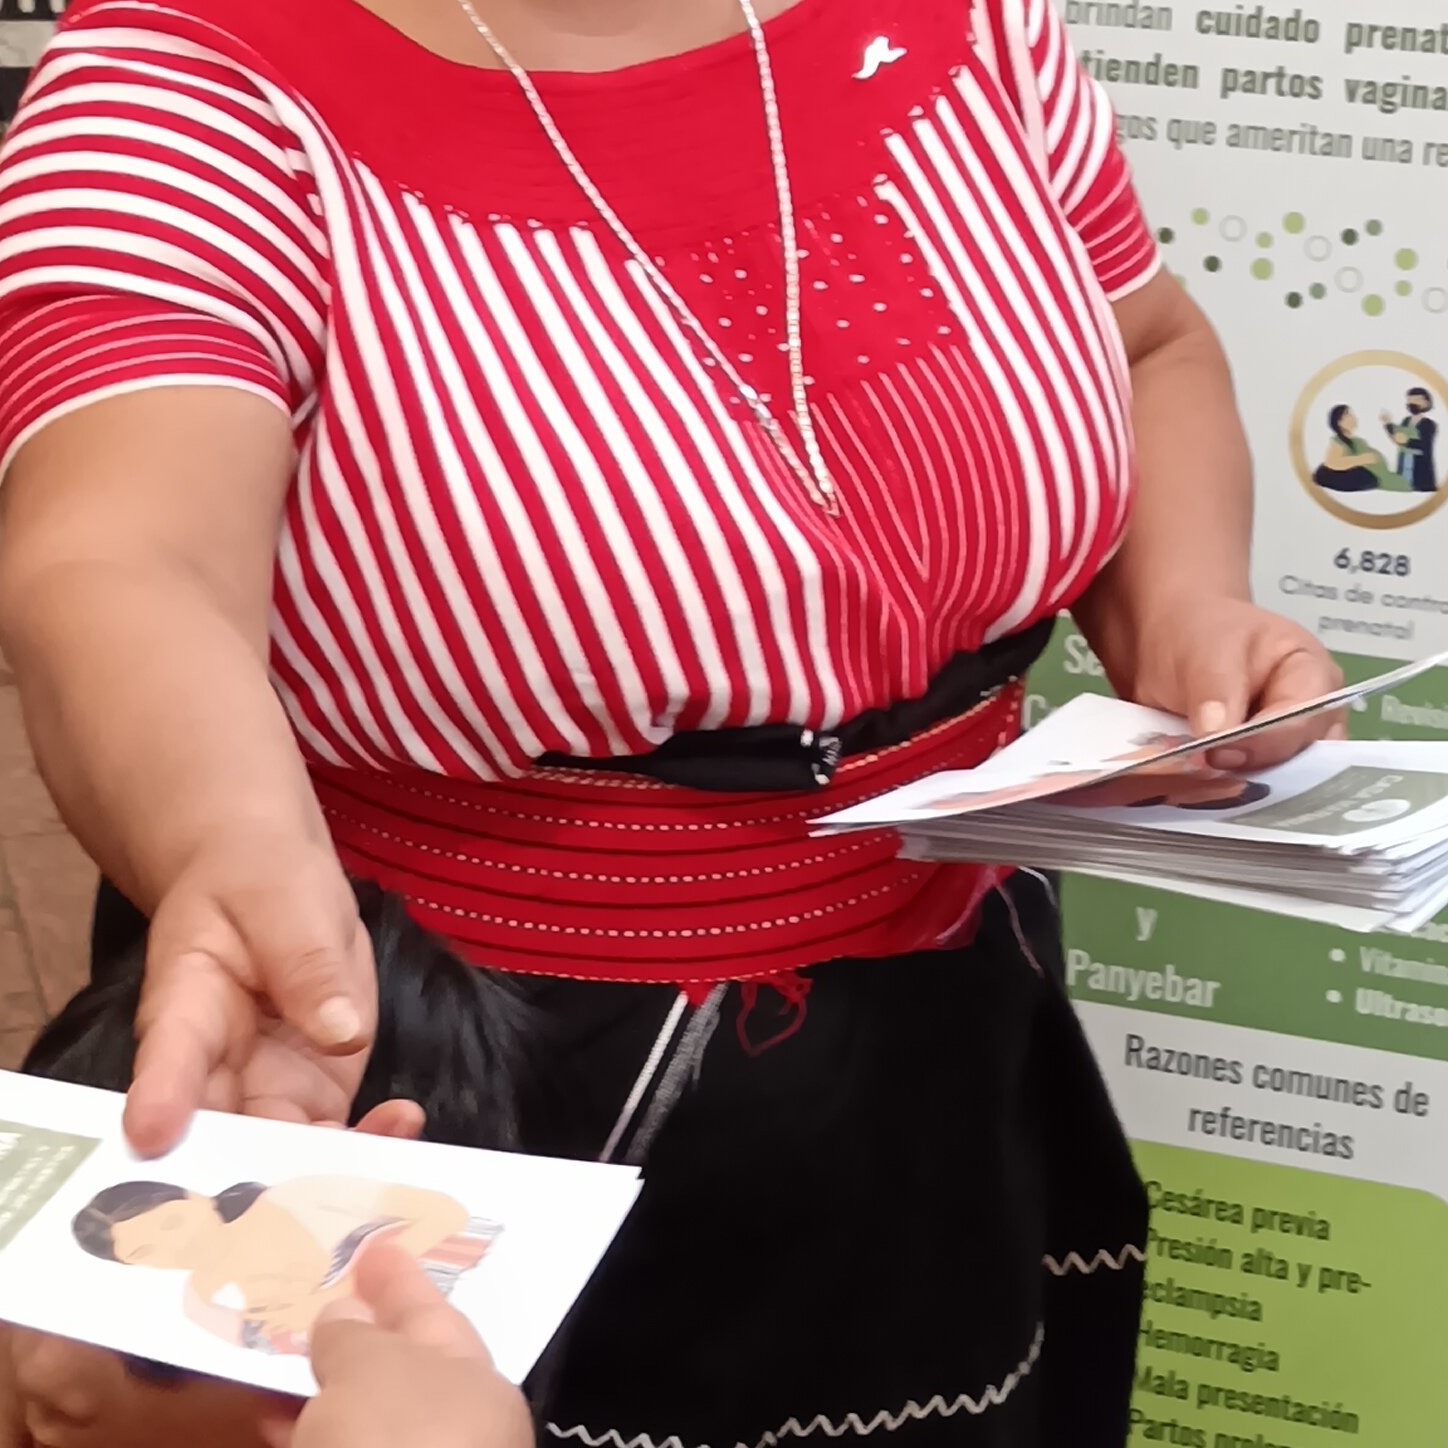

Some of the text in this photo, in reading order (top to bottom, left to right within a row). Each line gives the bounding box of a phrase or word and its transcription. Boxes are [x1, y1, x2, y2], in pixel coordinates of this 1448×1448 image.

[1197, 4, 1320, 46] cuidado
[1080, 44, 1200, 90] tienden
[1220, 62, 1323, 101] partos
[1166, 115, 1217, 149] que
[1226, 120, 1352, 159] ameritan
[1363, 135, 1413, 165] una
[1334, 547, 1411, 577] 6,828
[1279, 575, 1337, 601] Citas
[1345, 583, 1374, 605] de
[1319, 612, 1414, 640] prenatal
[1135, 906, 1157, 940] y
[1066, 948, 1221, 1008] Panyebar
[1126, 1034, 1429, 1116] Razones comunes de
[1188, 1107, 1354, 1159] referencias
[1145, 1180, 1330, 1240] Cesárea previa
[1241, 1249, 1371, 1293] alta pre-
[1129, 1408, 1206, 1448] Partos
[1197, 1382, 1359, 1433] presentación
